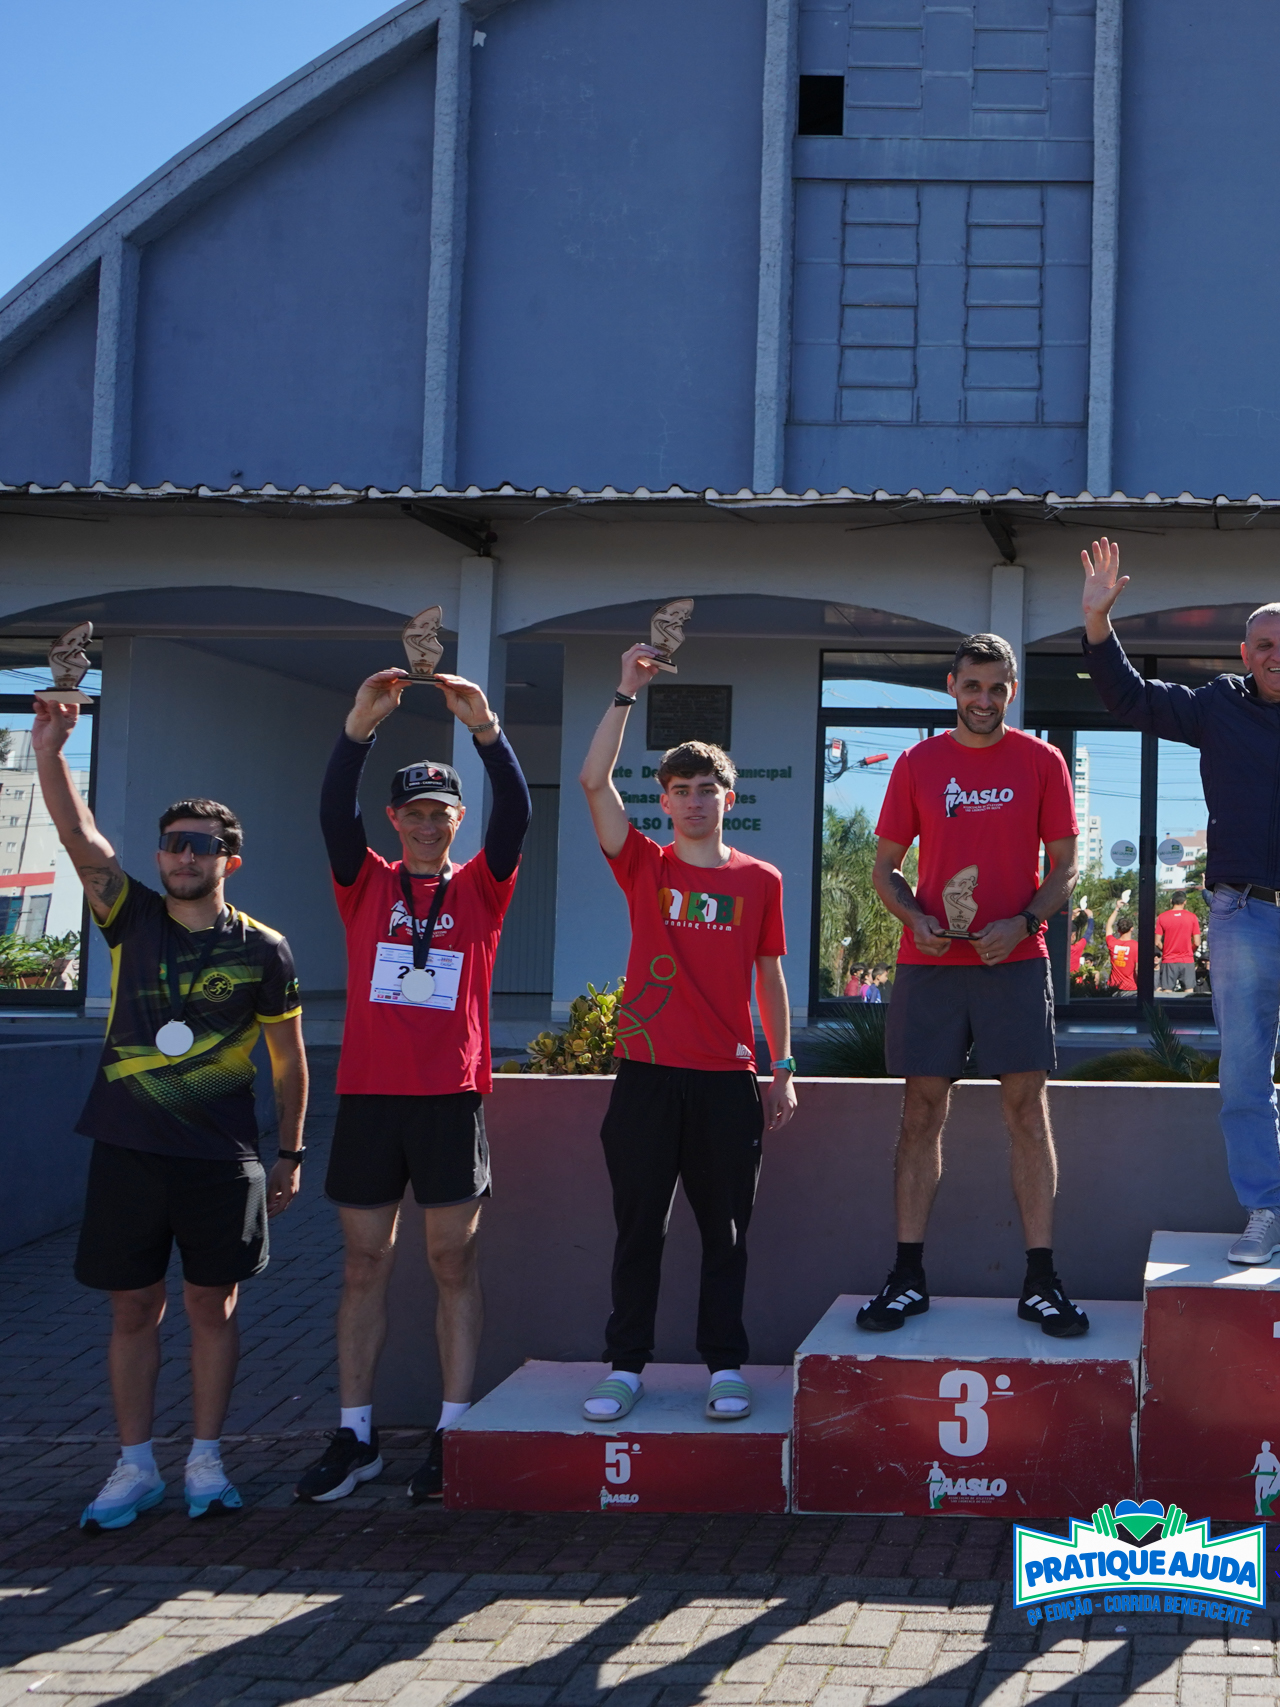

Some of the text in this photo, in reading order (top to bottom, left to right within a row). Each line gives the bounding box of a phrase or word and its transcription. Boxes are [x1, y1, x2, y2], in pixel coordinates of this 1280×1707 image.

[737, 766, 792, 781] unicipal
[955, 788, 1014, 805] AASLO
[723, 818, 761, 830] ROCE
[664, 920, 732, 932] unning team
[938, 1478, 1008, 1496] AASLO
[607, 1494, 640, 1504] AASLO
